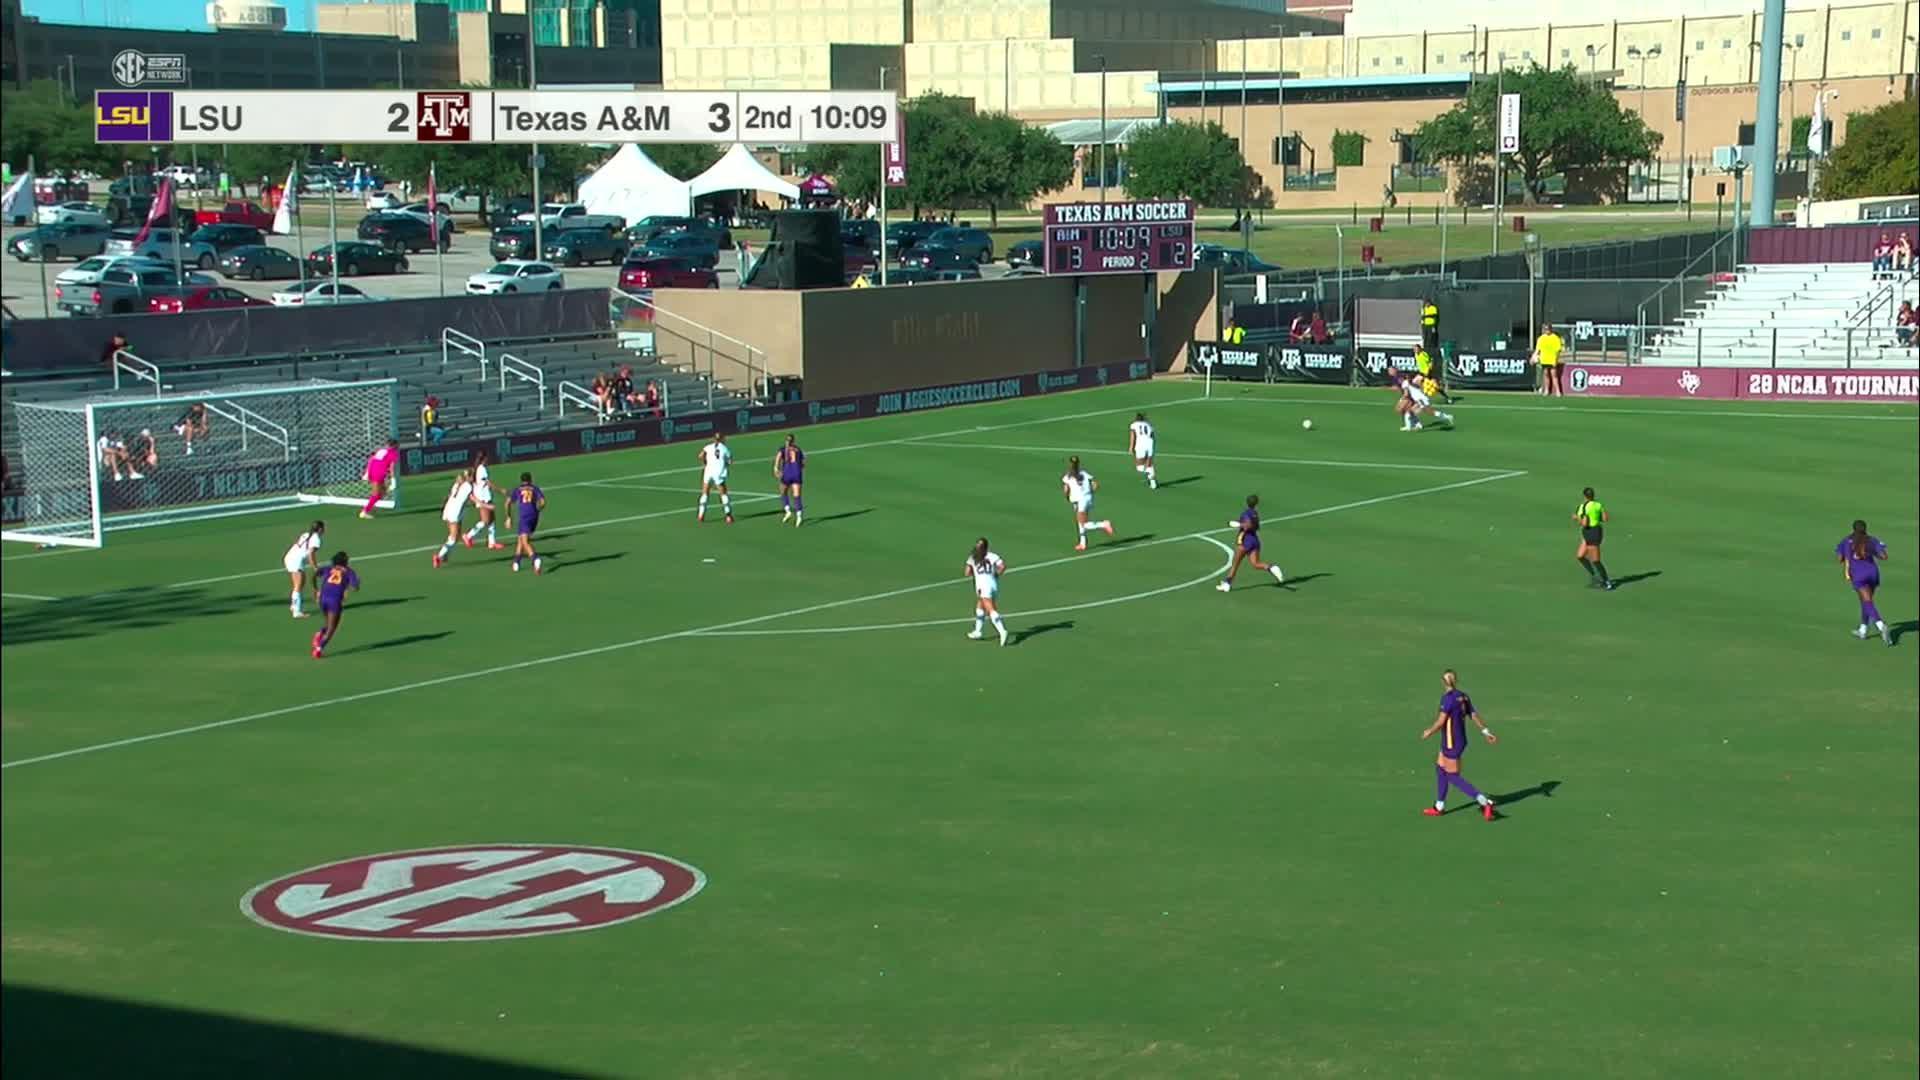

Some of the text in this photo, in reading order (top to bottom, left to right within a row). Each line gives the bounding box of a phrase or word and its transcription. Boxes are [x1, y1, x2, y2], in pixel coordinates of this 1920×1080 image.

[1055, 202, 1187, 223] TEXAS A&M SOCCER
[1098, 226, 1151, 250] 10:09
[1160, 225, 1184, 238] LSU
[1071, 242, 1186, 269] 3 2
[1102, 252, 1150, 269] PERIOD 2
[1588, 375, 1622, 387] SOCCER
[1749, 374, 1773, 394] 28
[1777, 375, 1828, 395] NCAA
[876, 392, 901, 414] JOIN
[274, 848, 666, 934] SEC
